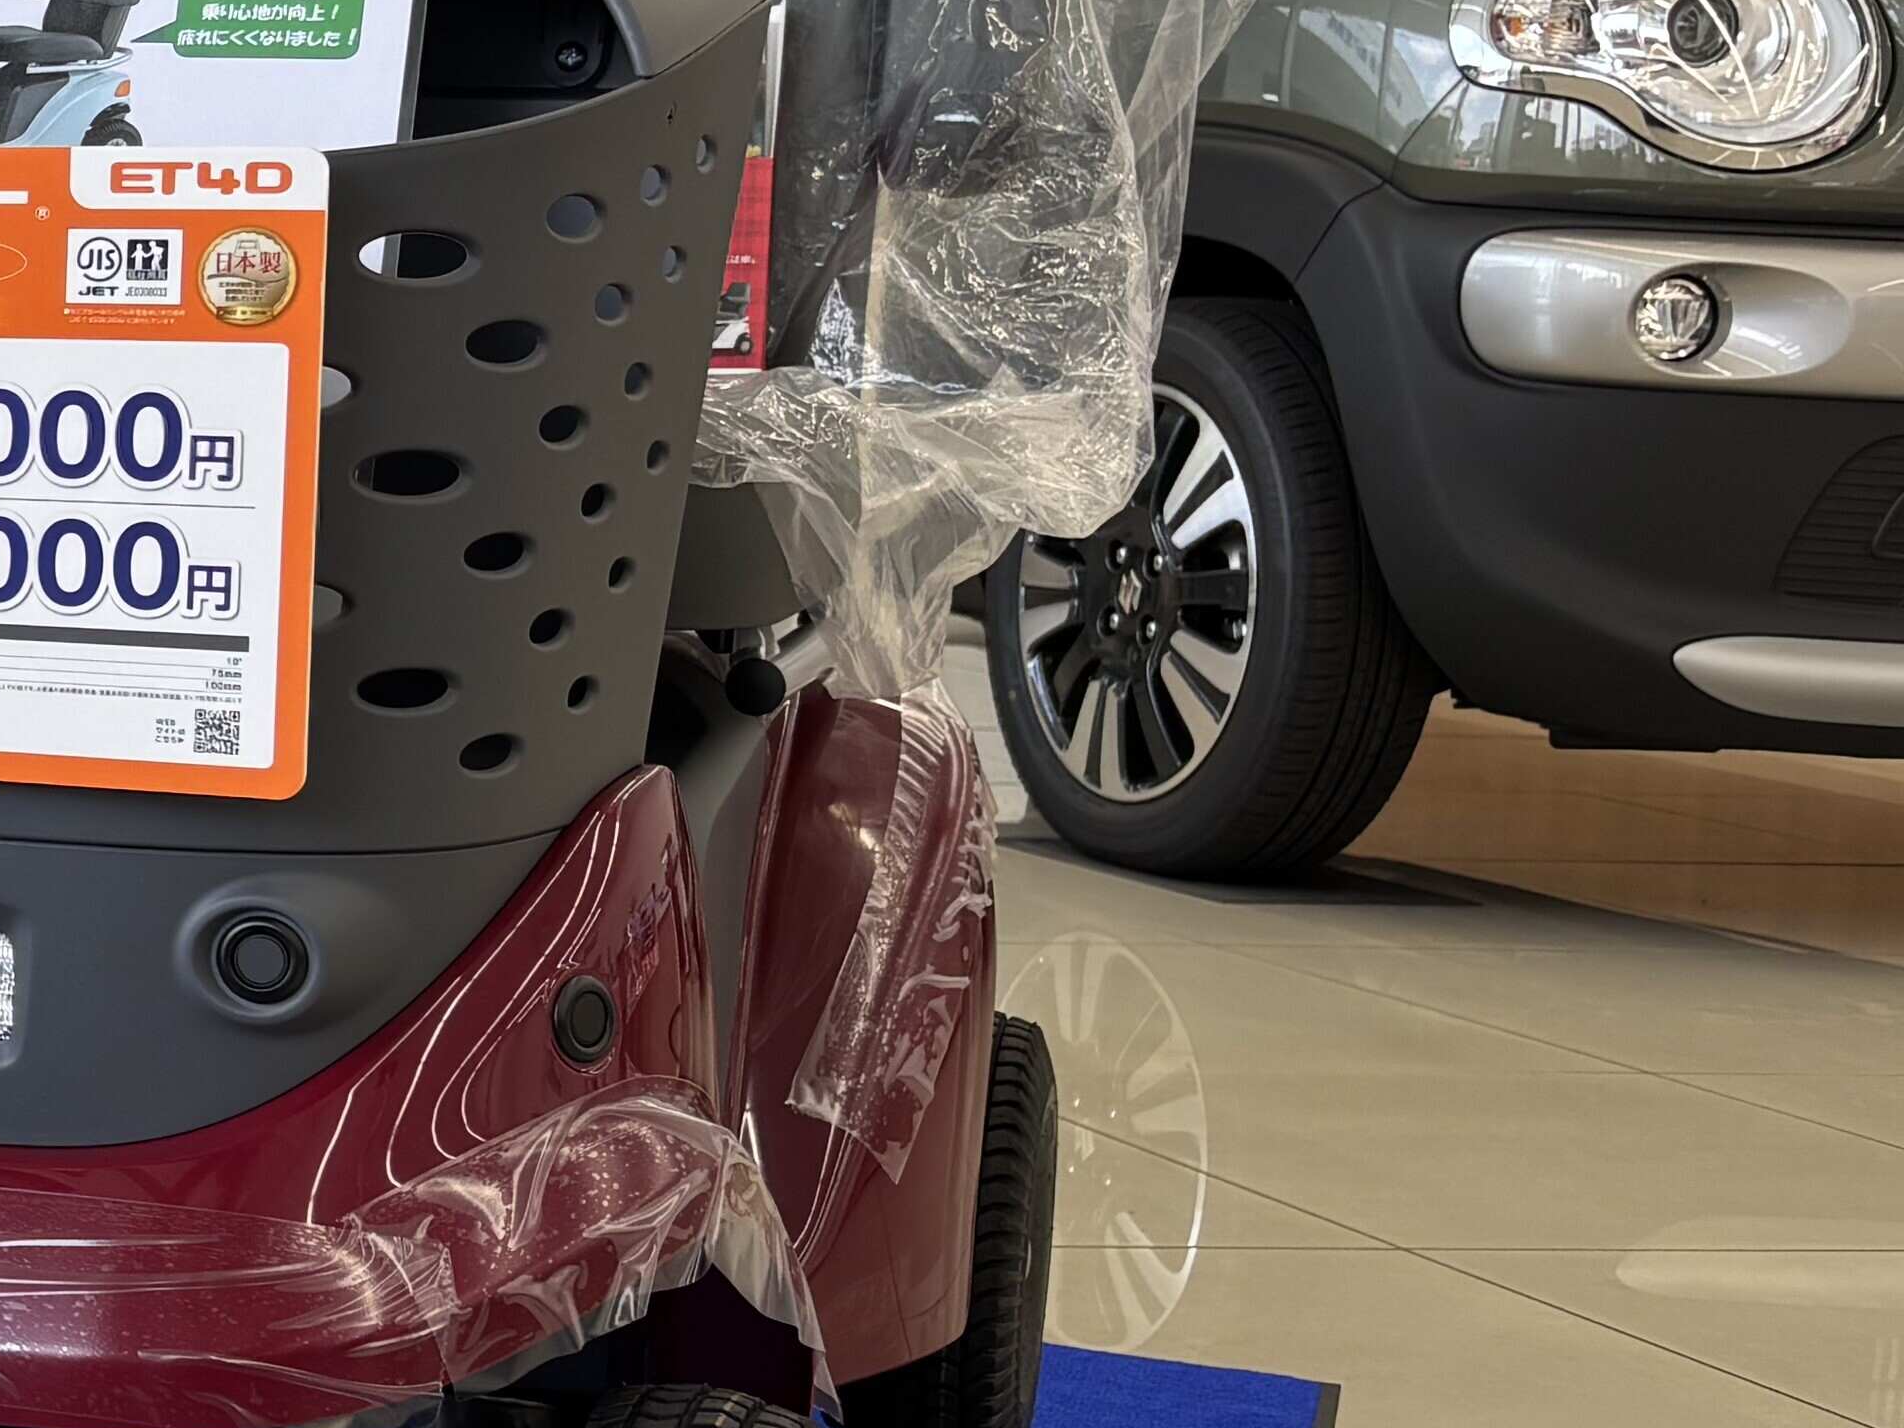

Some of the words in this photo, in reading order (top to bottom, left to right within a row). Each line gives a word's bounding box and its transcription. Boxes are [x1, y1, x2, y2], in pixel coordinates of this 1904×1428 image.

[110, 162, 293, 195] ET4D
[77, 249, 116, 270] JIS
[216, 251, 281, 274] 日本製
[78, 286, 120, 297] JET
